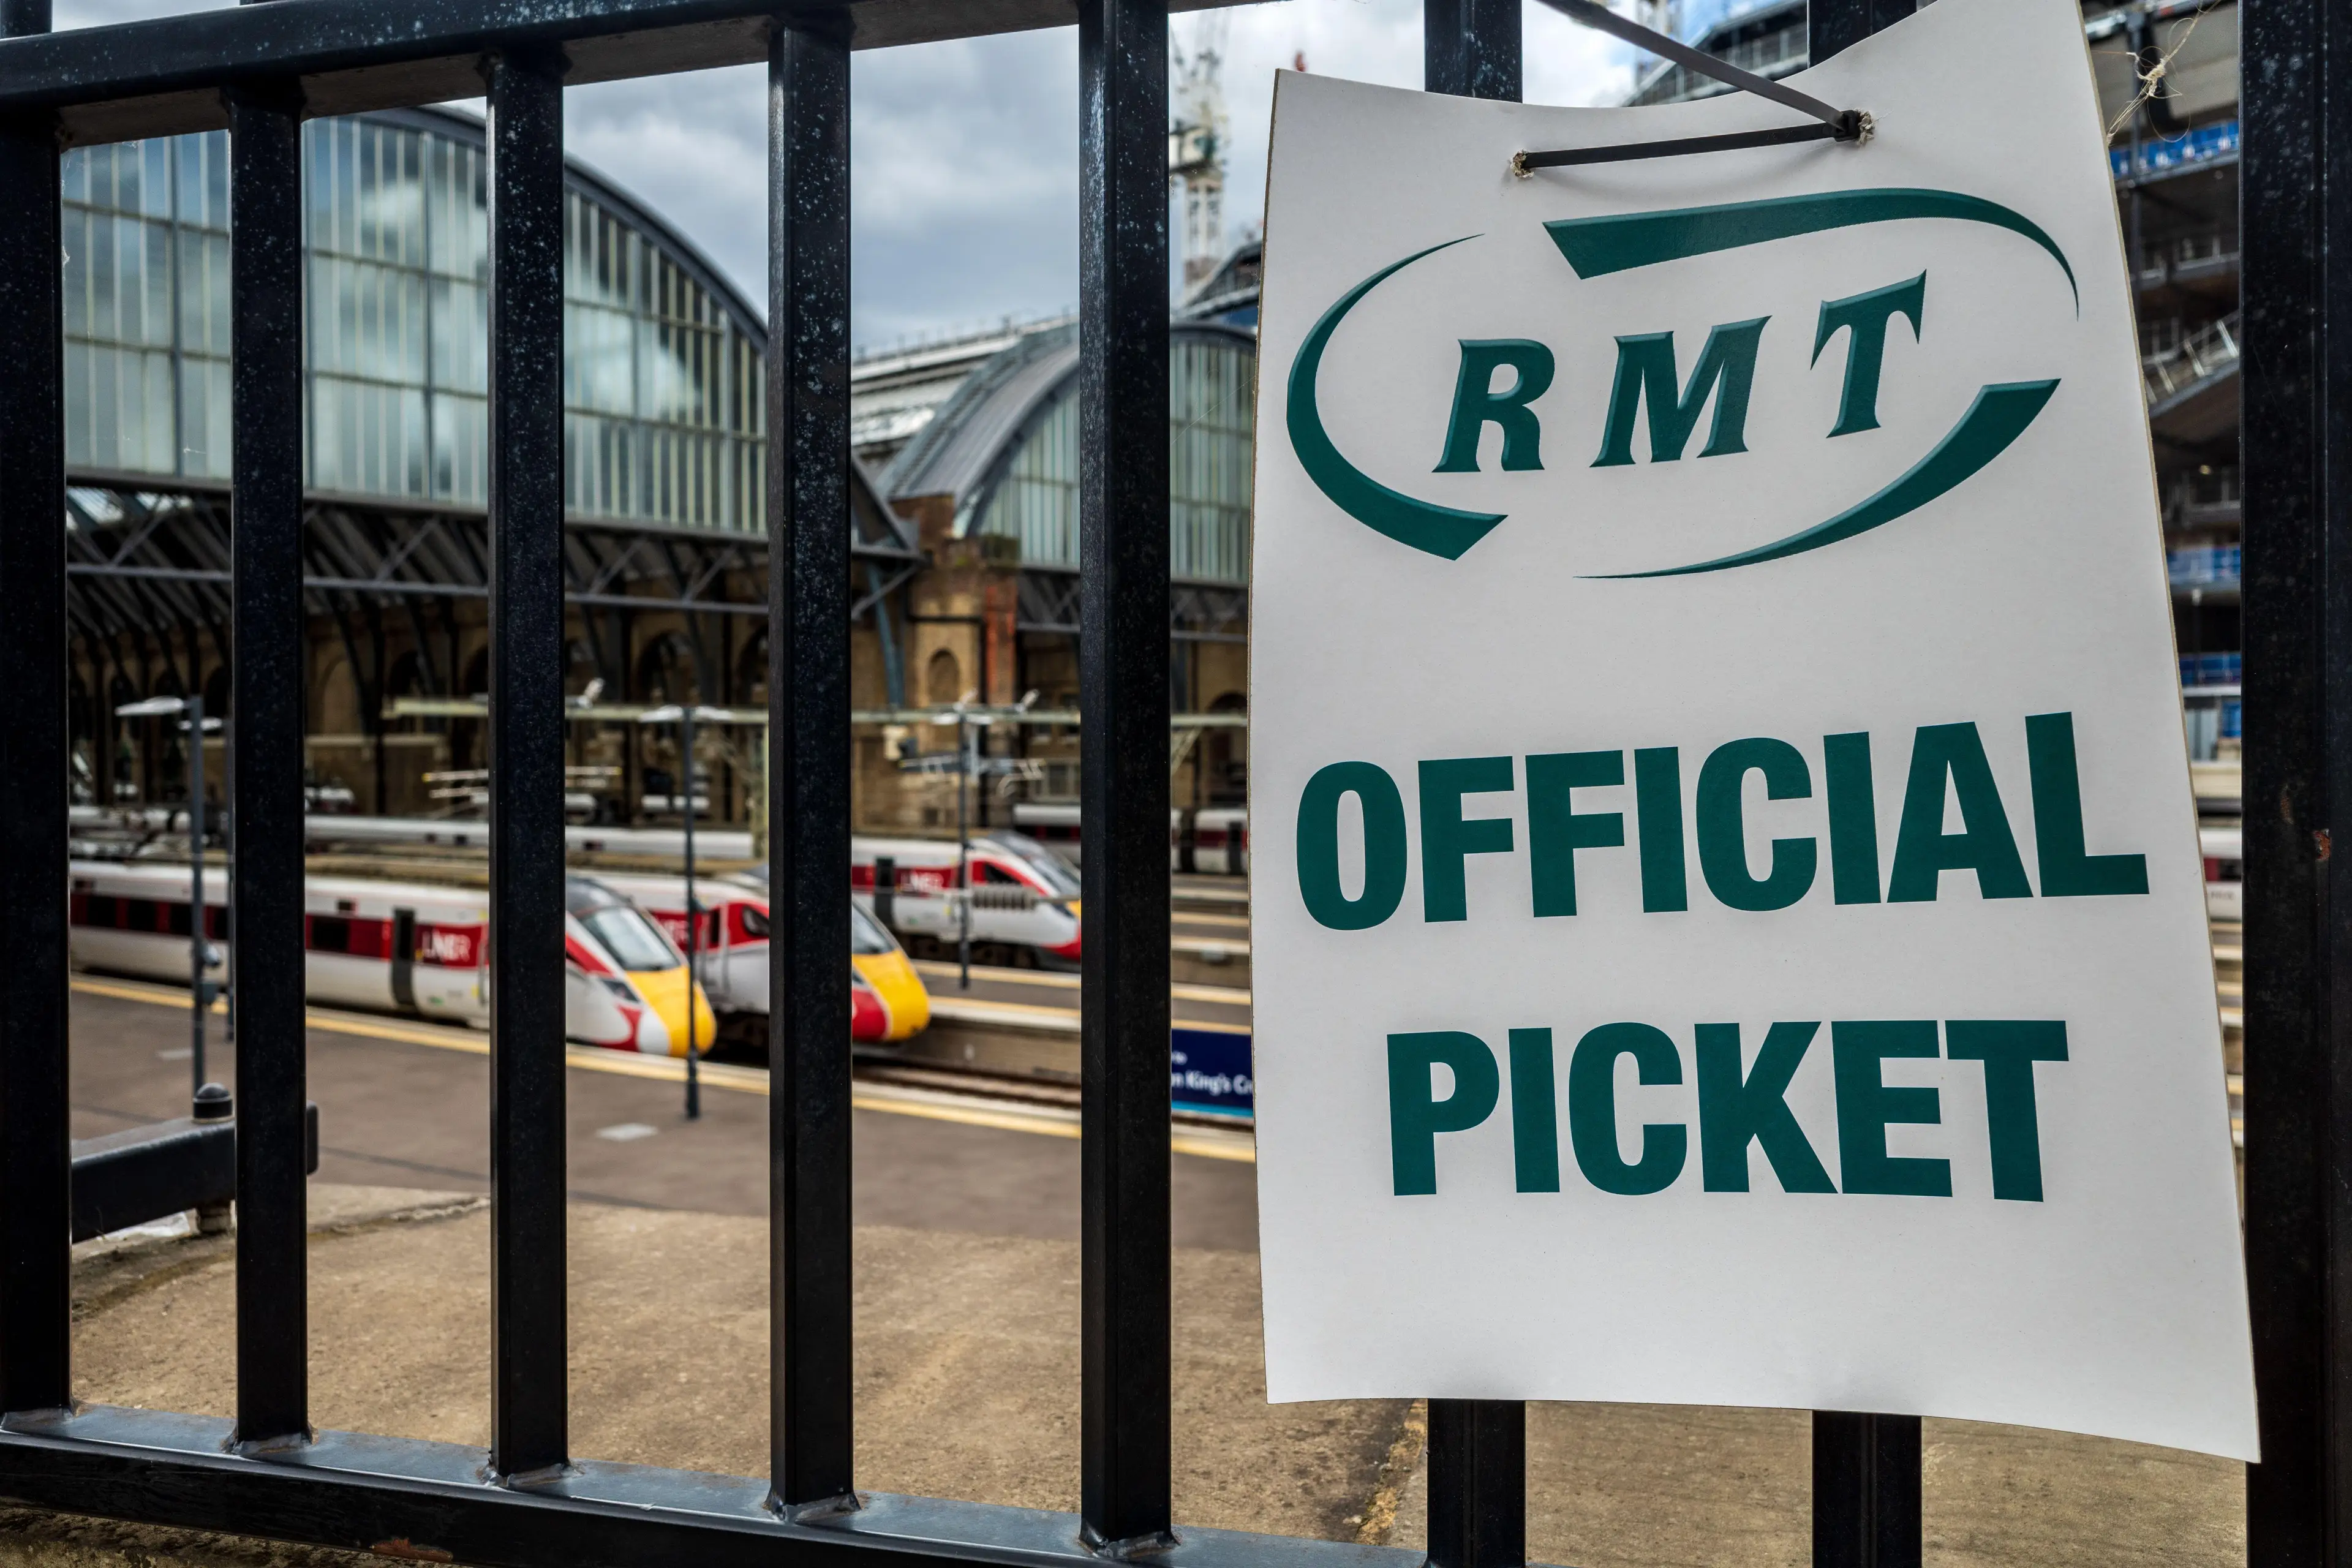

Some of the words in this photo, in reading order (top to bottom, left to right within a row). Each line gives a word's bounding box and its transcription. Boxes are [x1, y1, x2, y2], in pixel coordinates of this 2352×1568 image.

[1431, 268, 1928, 473] RMT
[1296, 711, 2150, 931] OFFICIAL
[1386, 1020, 2070, 1203] PICKET
